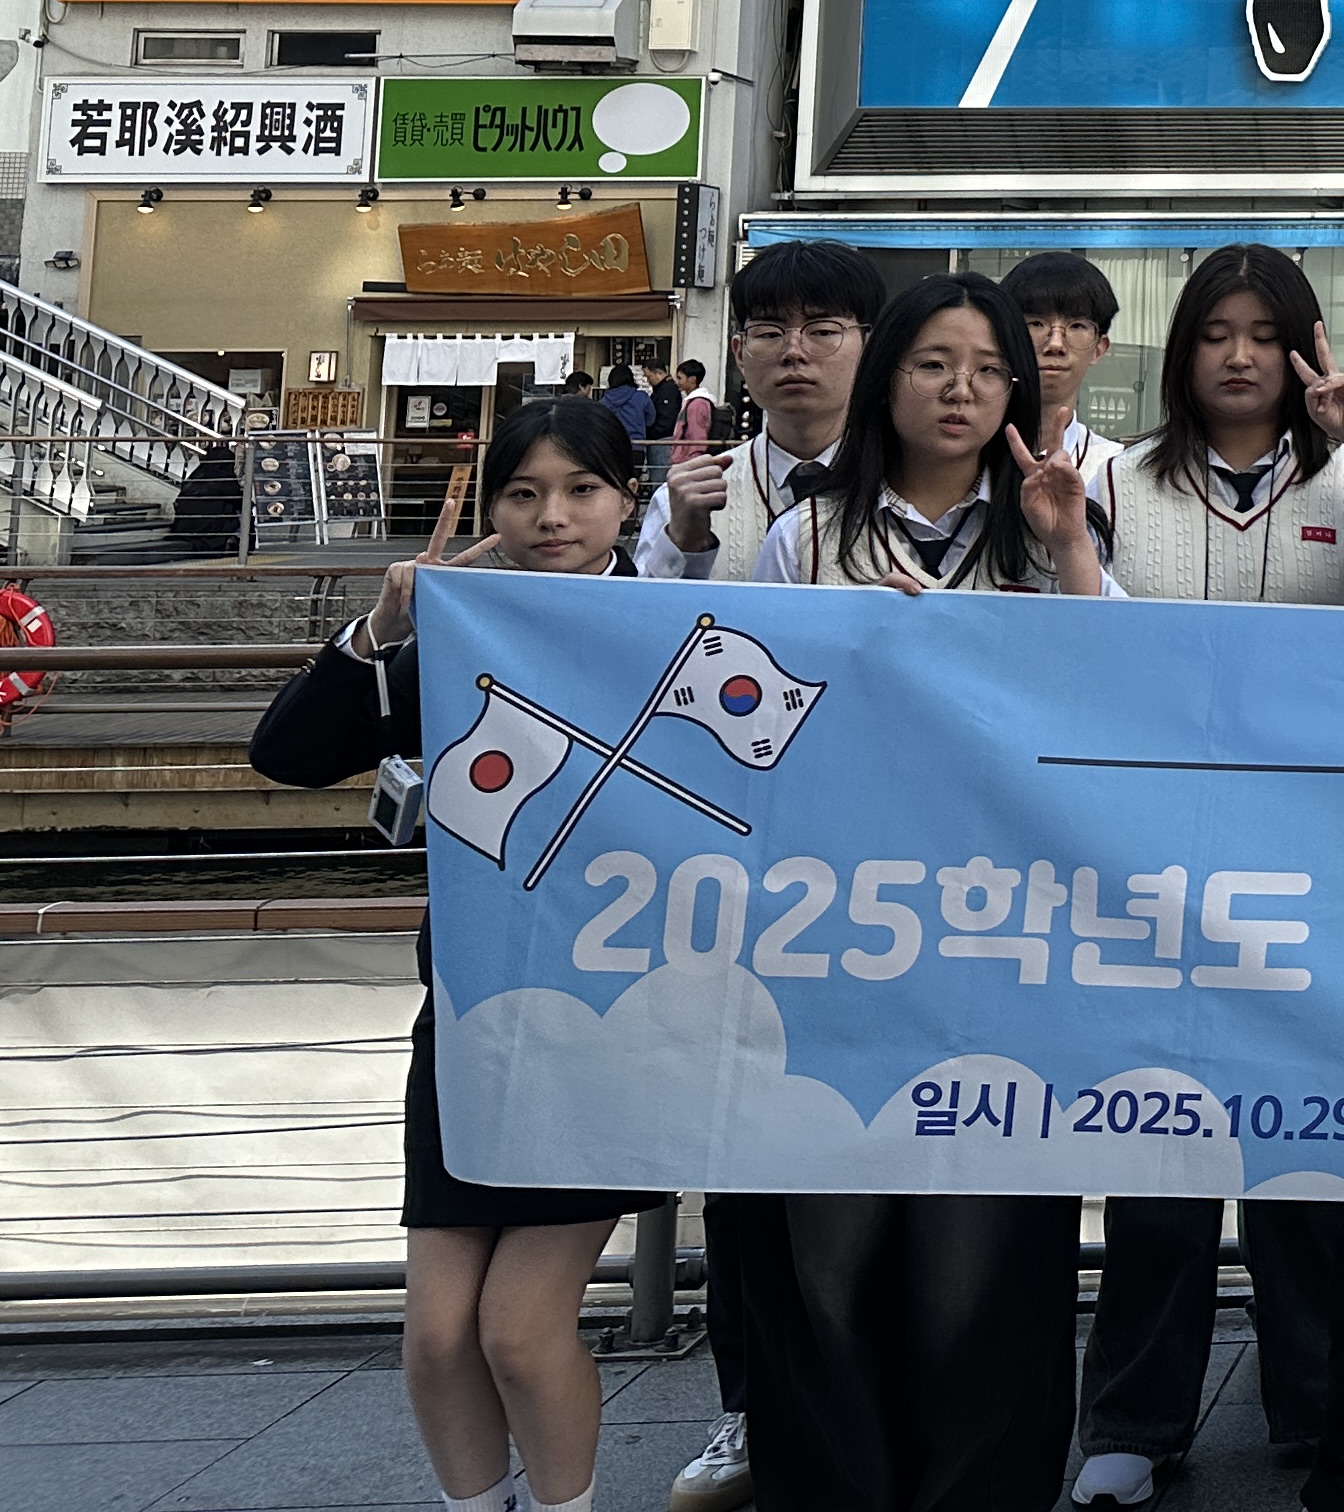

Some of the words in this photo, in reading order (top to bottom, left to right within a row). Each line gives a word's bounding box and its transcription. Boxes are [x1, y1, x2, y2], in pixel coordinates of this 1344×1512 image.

[473, 104, 584, 152] ピタットハウス
[571, 849, 1312, 993] 2025학년도
[910, 1080, 1017, 1139] 일시
